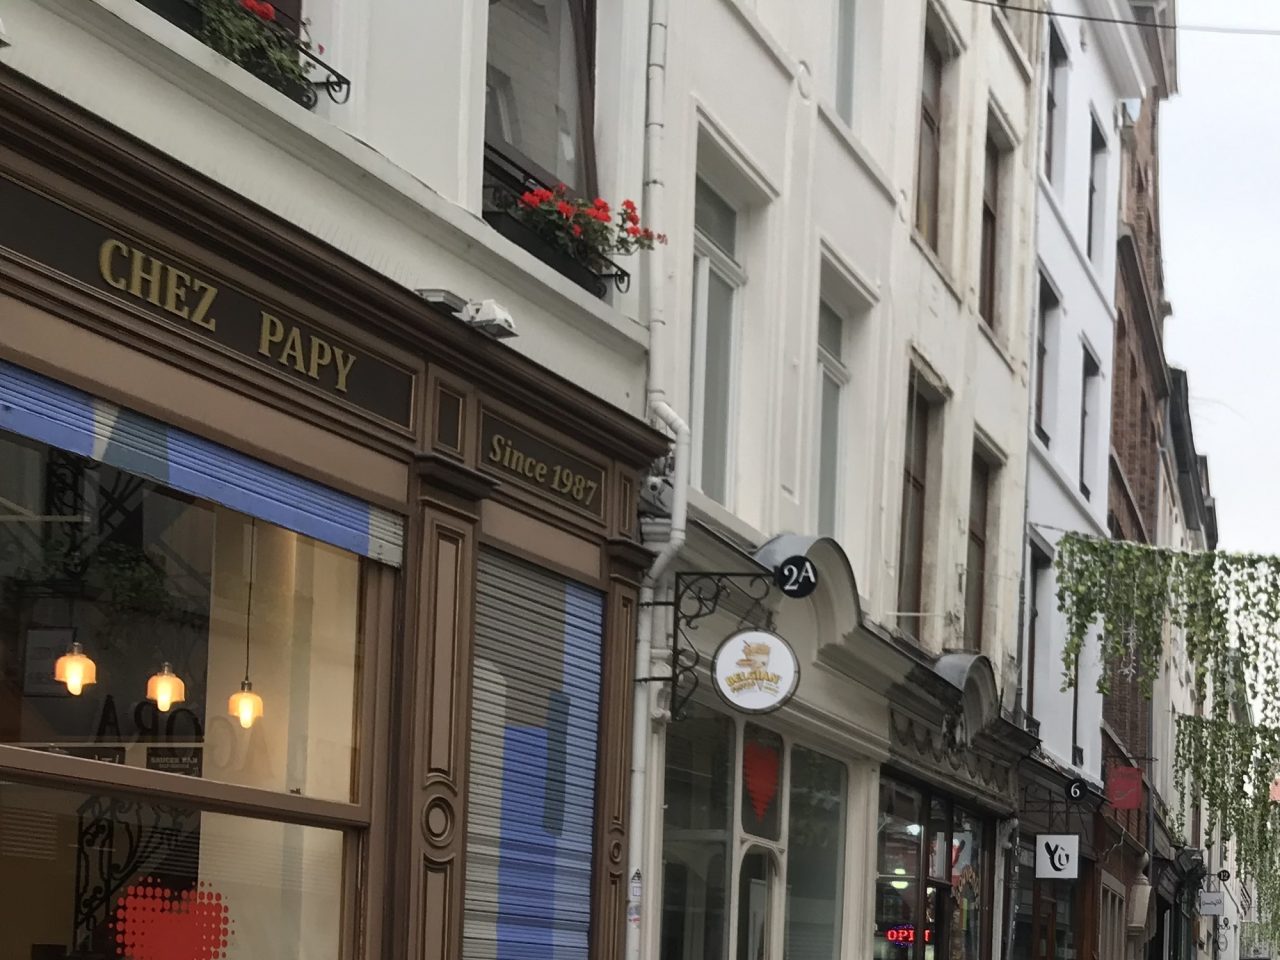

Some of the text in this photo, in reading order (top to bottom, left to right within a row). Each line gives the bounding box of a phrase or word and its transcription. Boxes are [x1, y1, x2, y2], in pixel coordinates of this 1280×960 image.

[99, 238, 357, 393] CHEZ PAPY
[488, 434, 598, 506] Since 1987
[783, 561, 815, 591] 2A
[1071, 783, 1080, 798] 6
